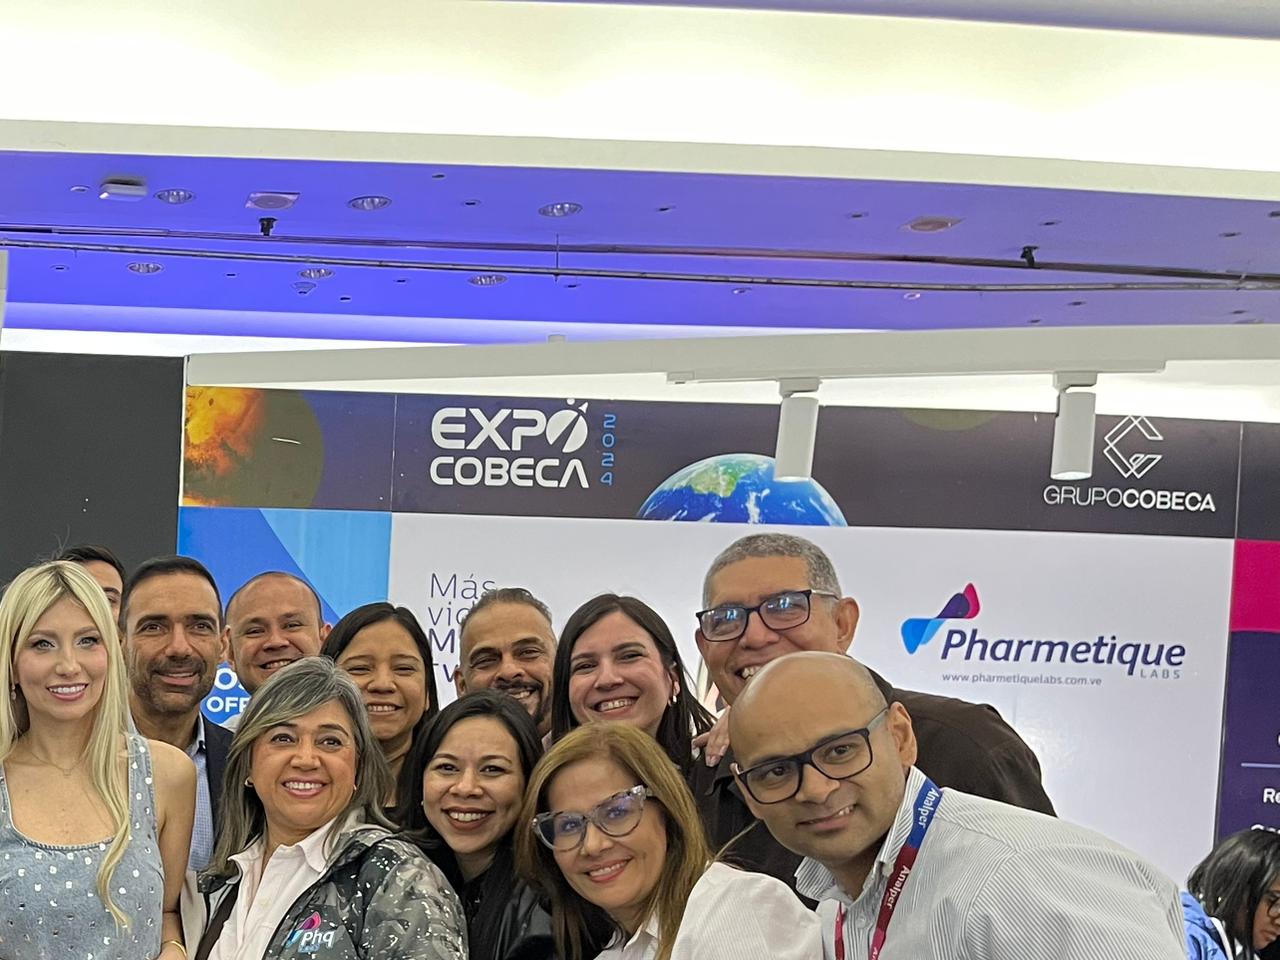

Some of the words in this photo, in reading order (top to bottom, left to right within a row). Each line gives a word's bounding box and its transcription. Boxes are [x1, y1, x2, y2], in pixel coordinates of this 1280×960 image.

[430, 456, 589, 489] COBECA
[940, 628, 1186, 676] Pharmetique
[1140, 669, 1181, 679] LABS
[918, 787, 940, 829] Analper
[886, 865, 912, 910] Analper
